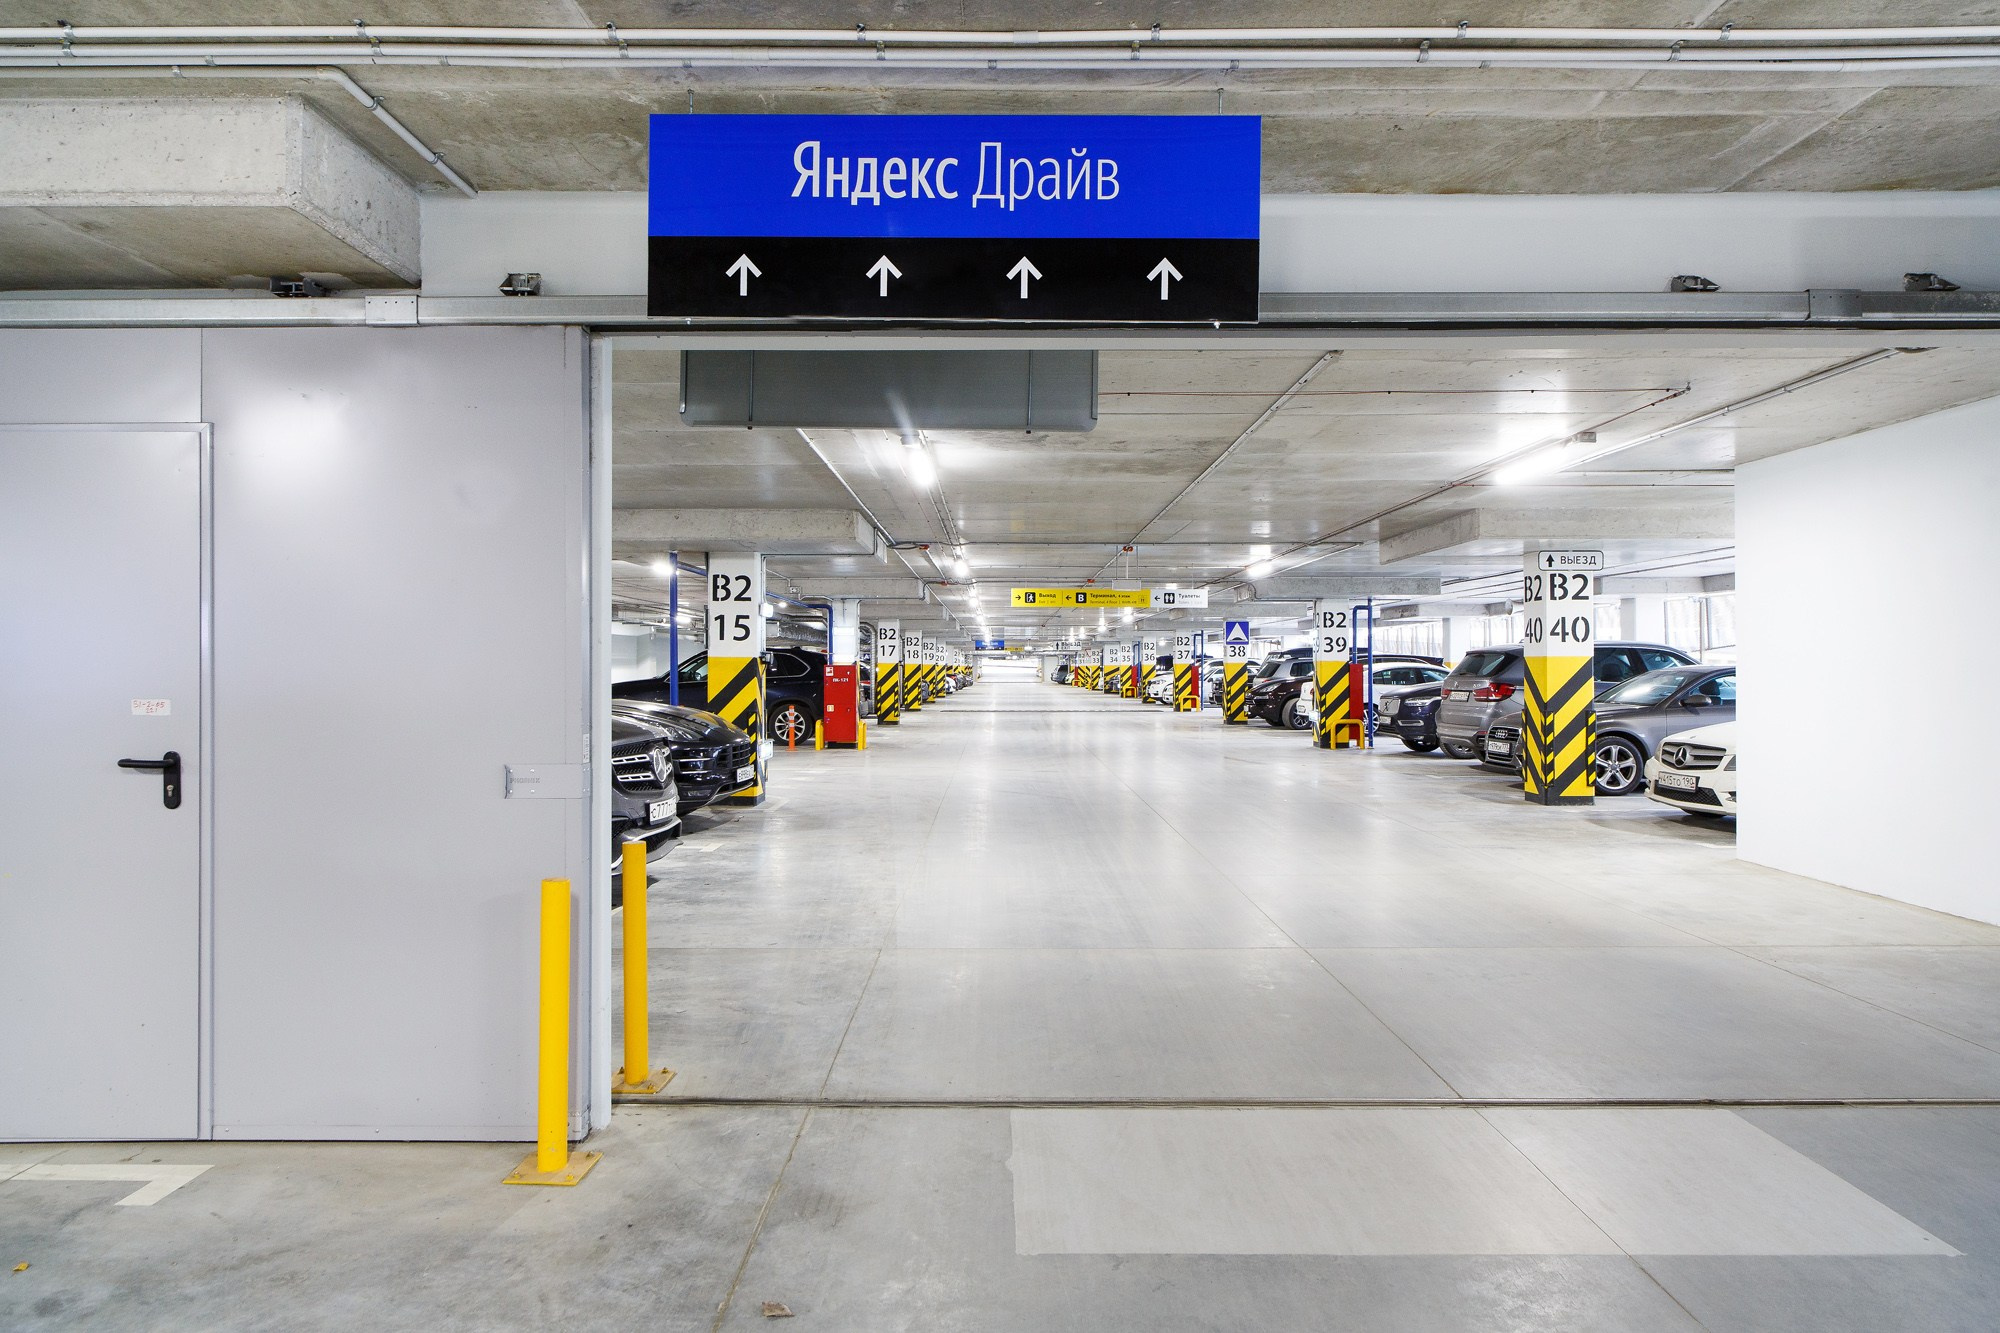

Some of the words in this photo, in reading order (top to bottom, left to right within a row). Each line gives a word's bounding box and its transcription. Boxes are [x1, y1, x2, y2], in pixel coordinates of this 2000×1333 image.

[791, 140, 959, 206] Яндекс
[971, 141, 1120, 212] Драйв
[1560, 555, 1597, 566] ВЫЕЗД
[713, 614, 751, 642] 15
[1525, 616, 1543, 643] 40
[1549, 616, 1590, 643] 40
[1323, 636, 1347, 653] 39
[880, 645, 896, 657] 17
[906, 649, 920, 659] 18
[923, 653, 935, 661] 19
[1177, 650, 1190, 660] 37
[1228, 645, 1246, 657] 38
[1121, 655, 1131, 663] 35
[1144, 653, 1156, 662] 36
